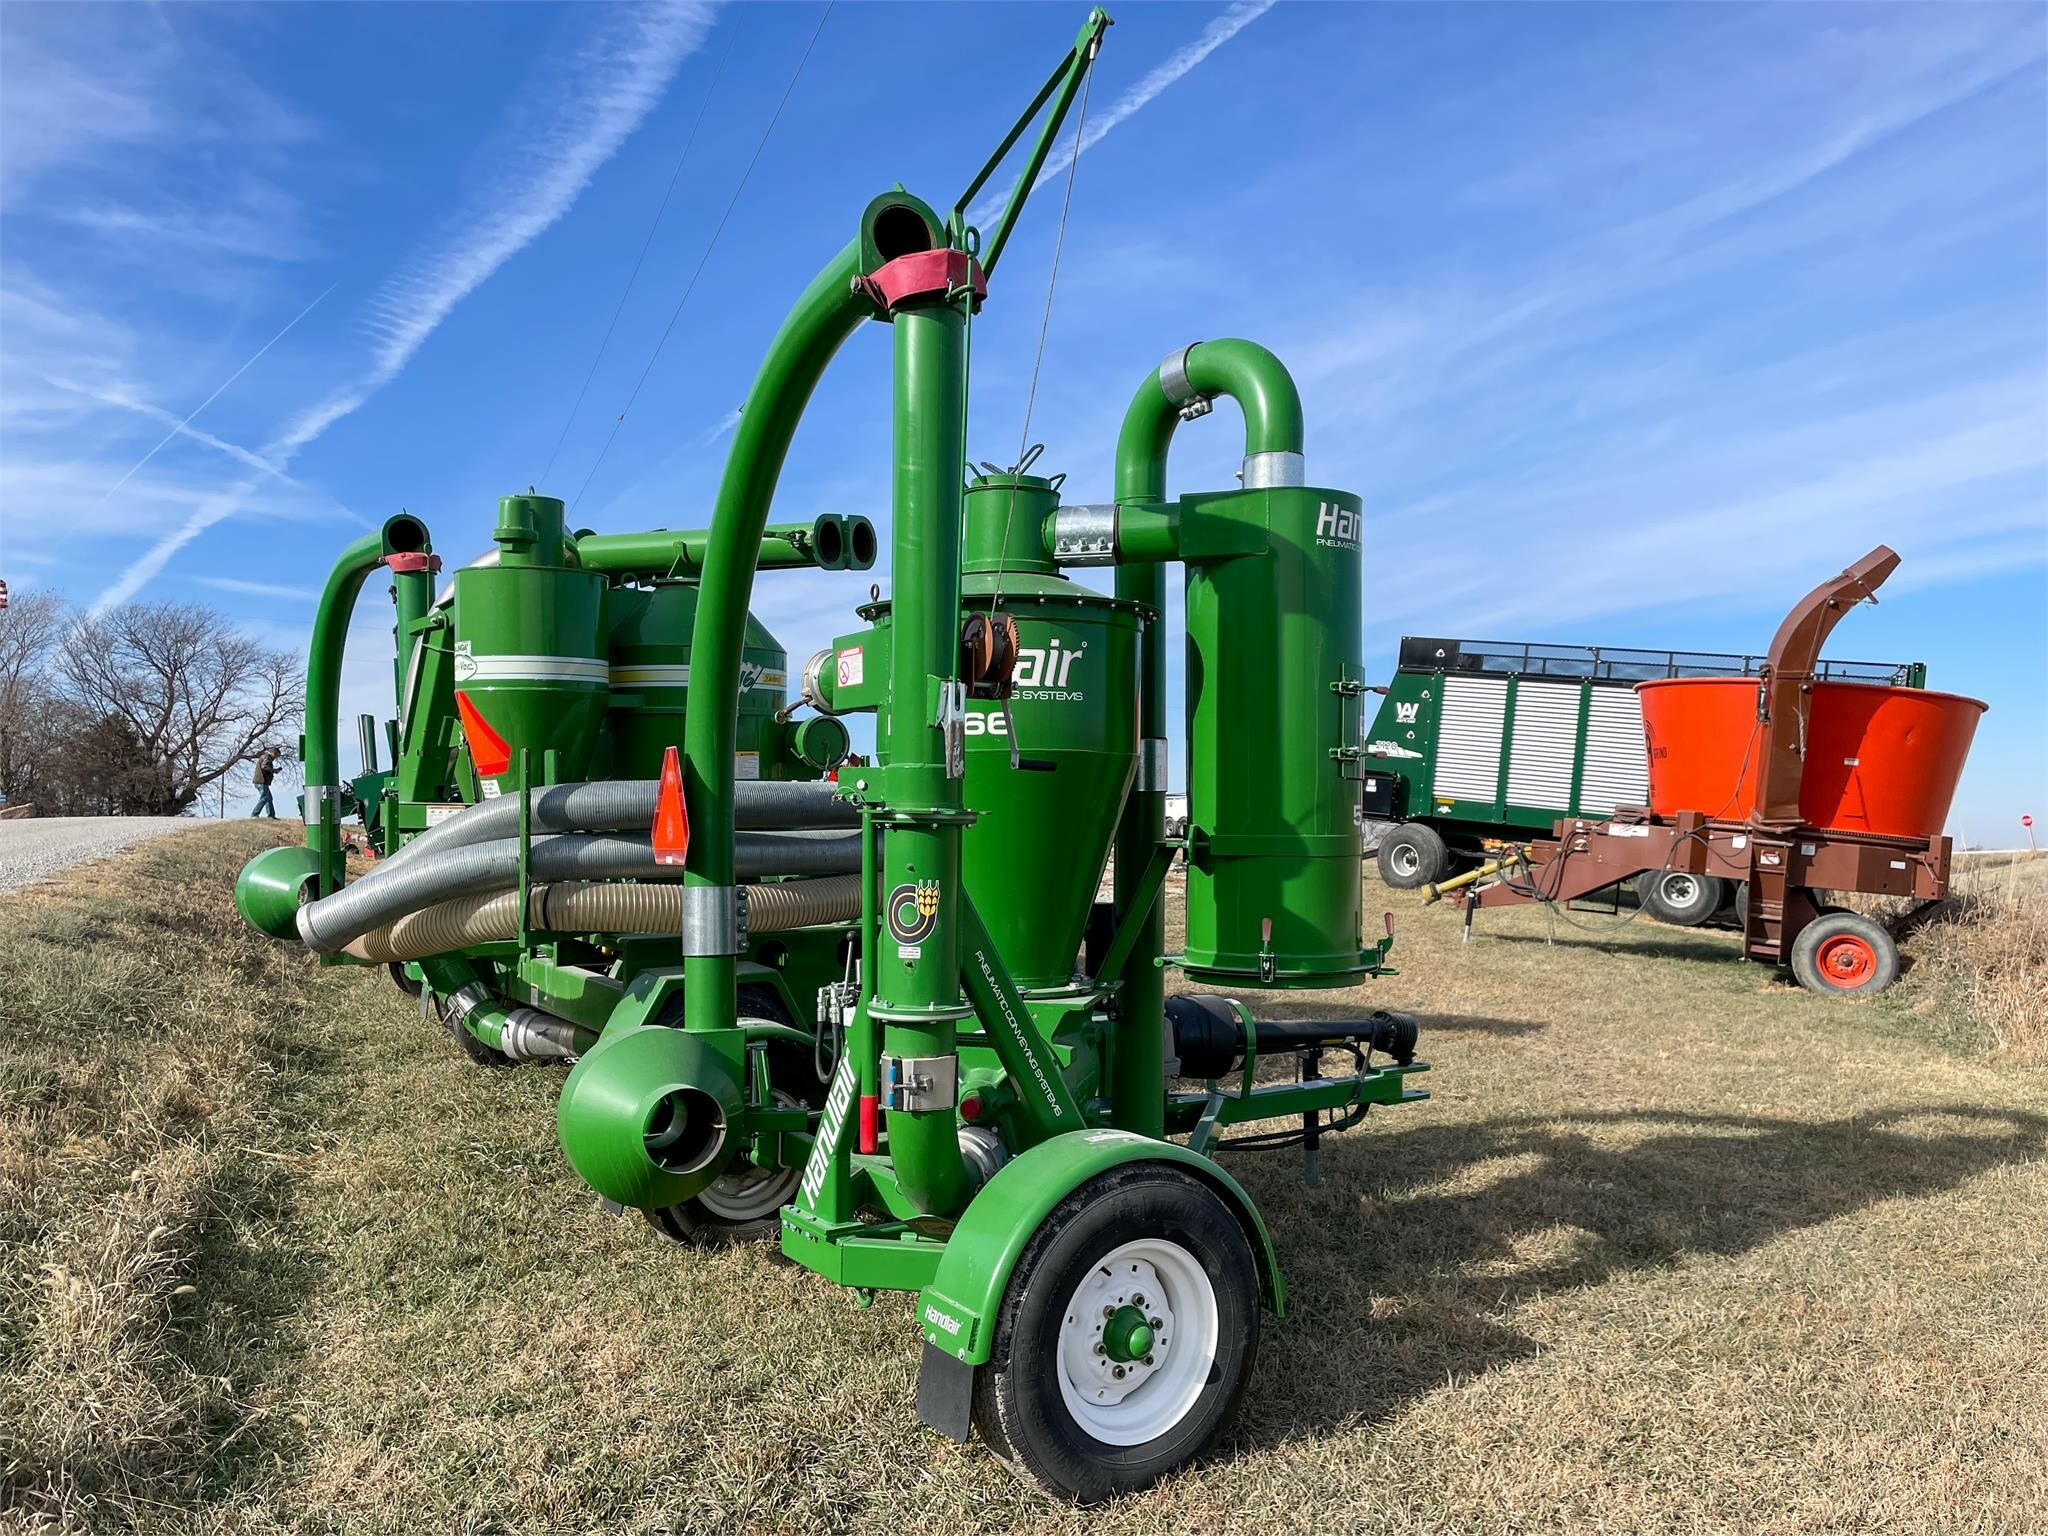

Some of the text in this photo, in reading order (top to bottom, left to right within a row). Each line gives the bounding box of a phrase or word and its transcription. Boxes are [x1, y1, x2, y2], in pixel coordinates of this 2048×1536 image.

[1022, 690, 1084, 701] SYSTEMS
[975, 950, 1063, 1117] PNEUMATIC CONVEYING SYSTEMS
[924, 1303, 963, 1336] Handlair
